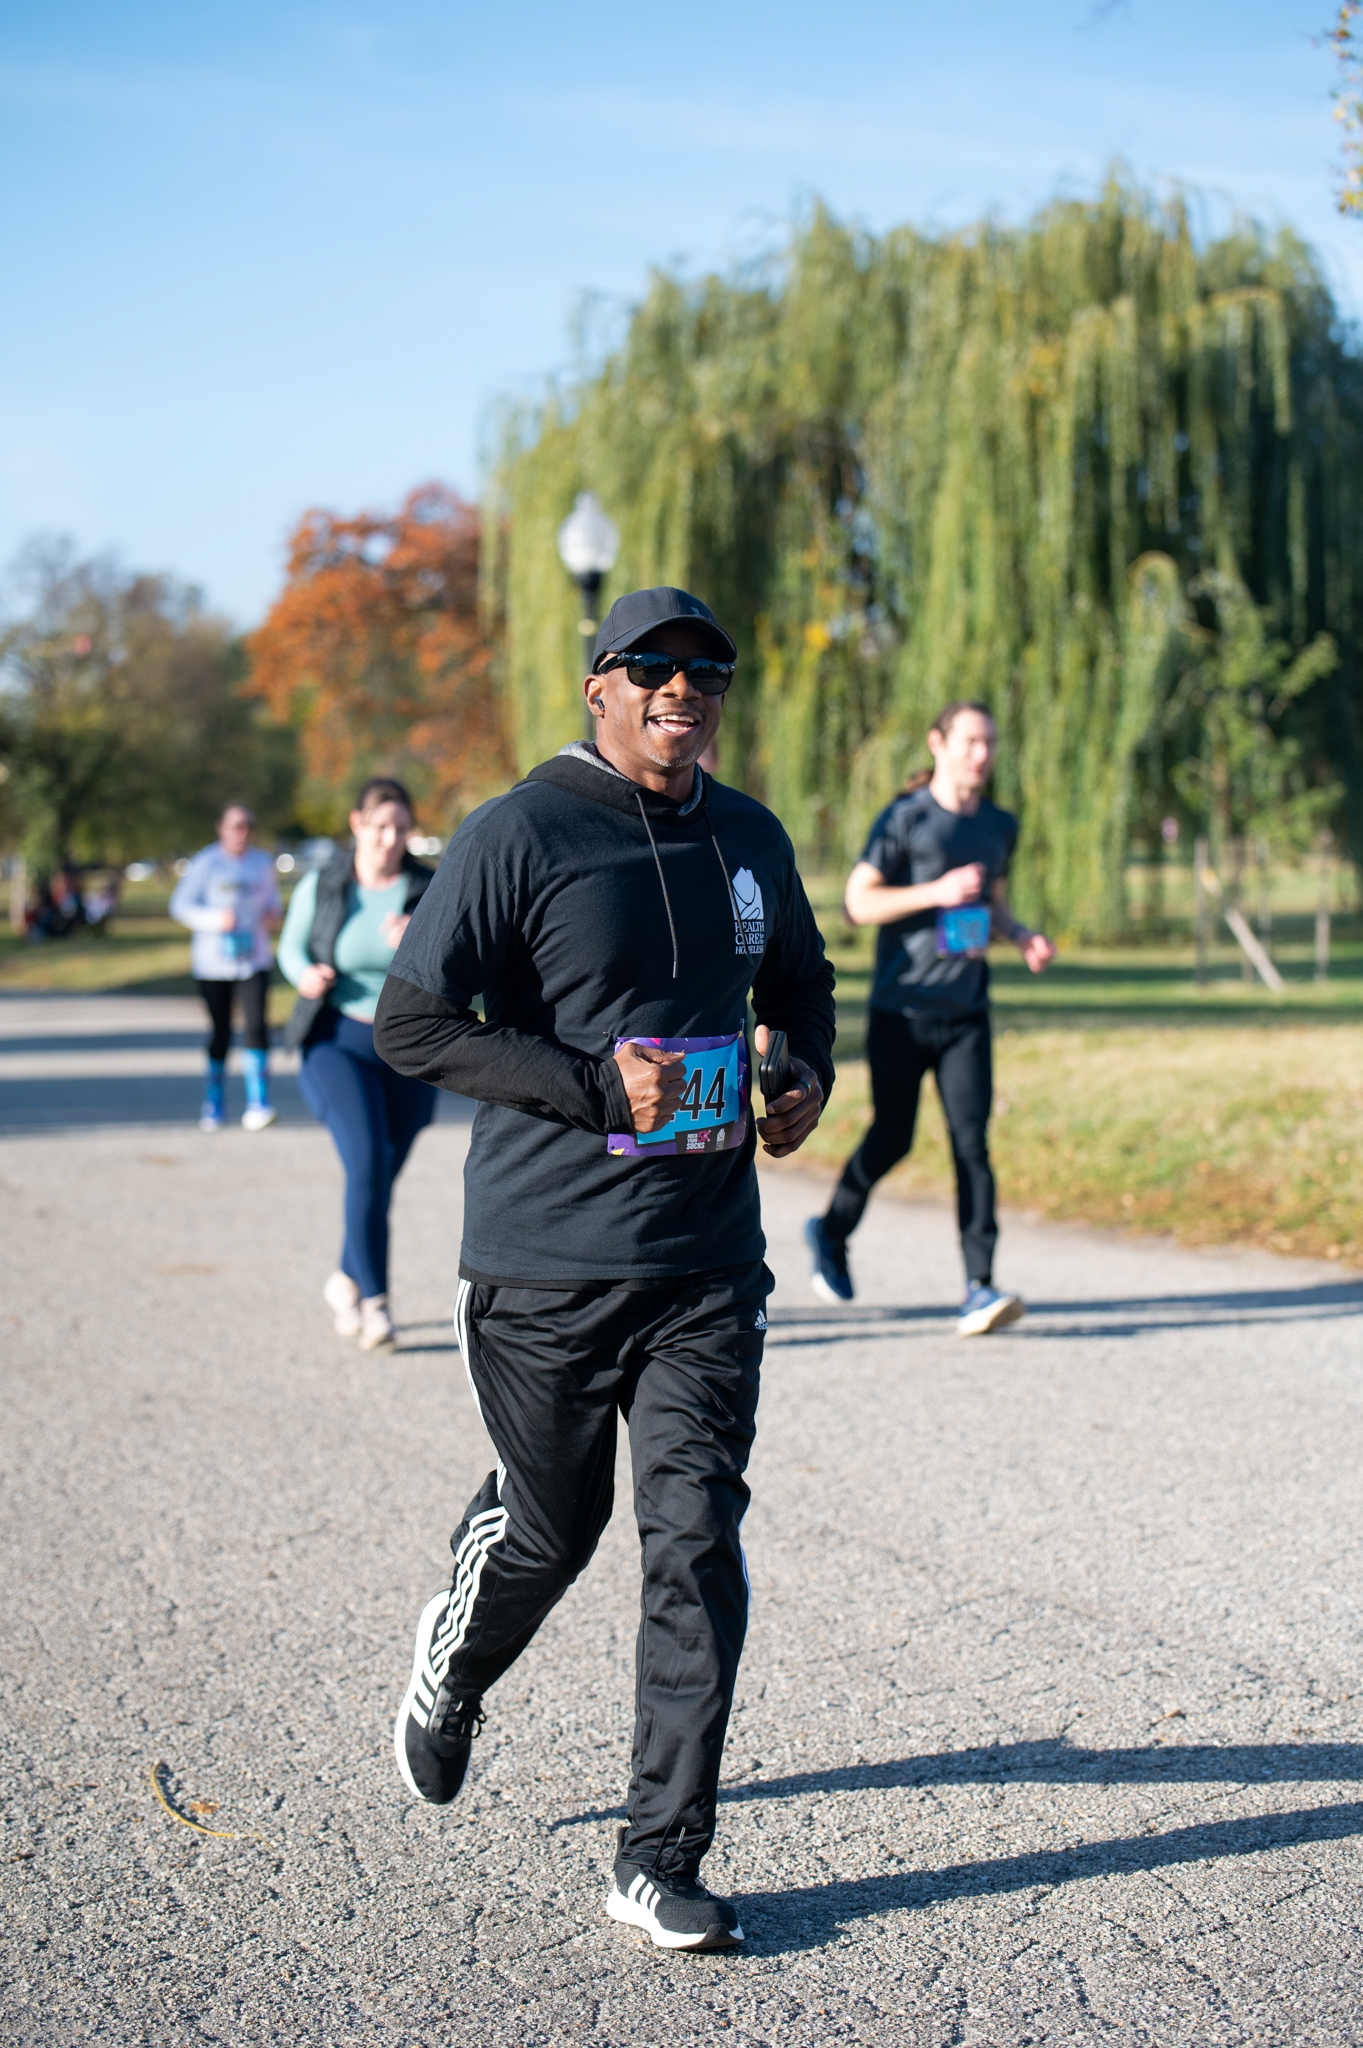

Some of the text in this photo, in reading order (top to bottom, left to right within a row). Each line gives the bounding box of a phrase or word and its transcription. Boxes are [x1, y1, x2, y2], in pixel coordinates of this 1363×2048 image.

[734, 921, 764, 932] HEALTH
[670, 1067, 726, 1122] 44
[698, 1130, 711, 1142] 5K
[686, 1142, 705, 1150] SOCKS
